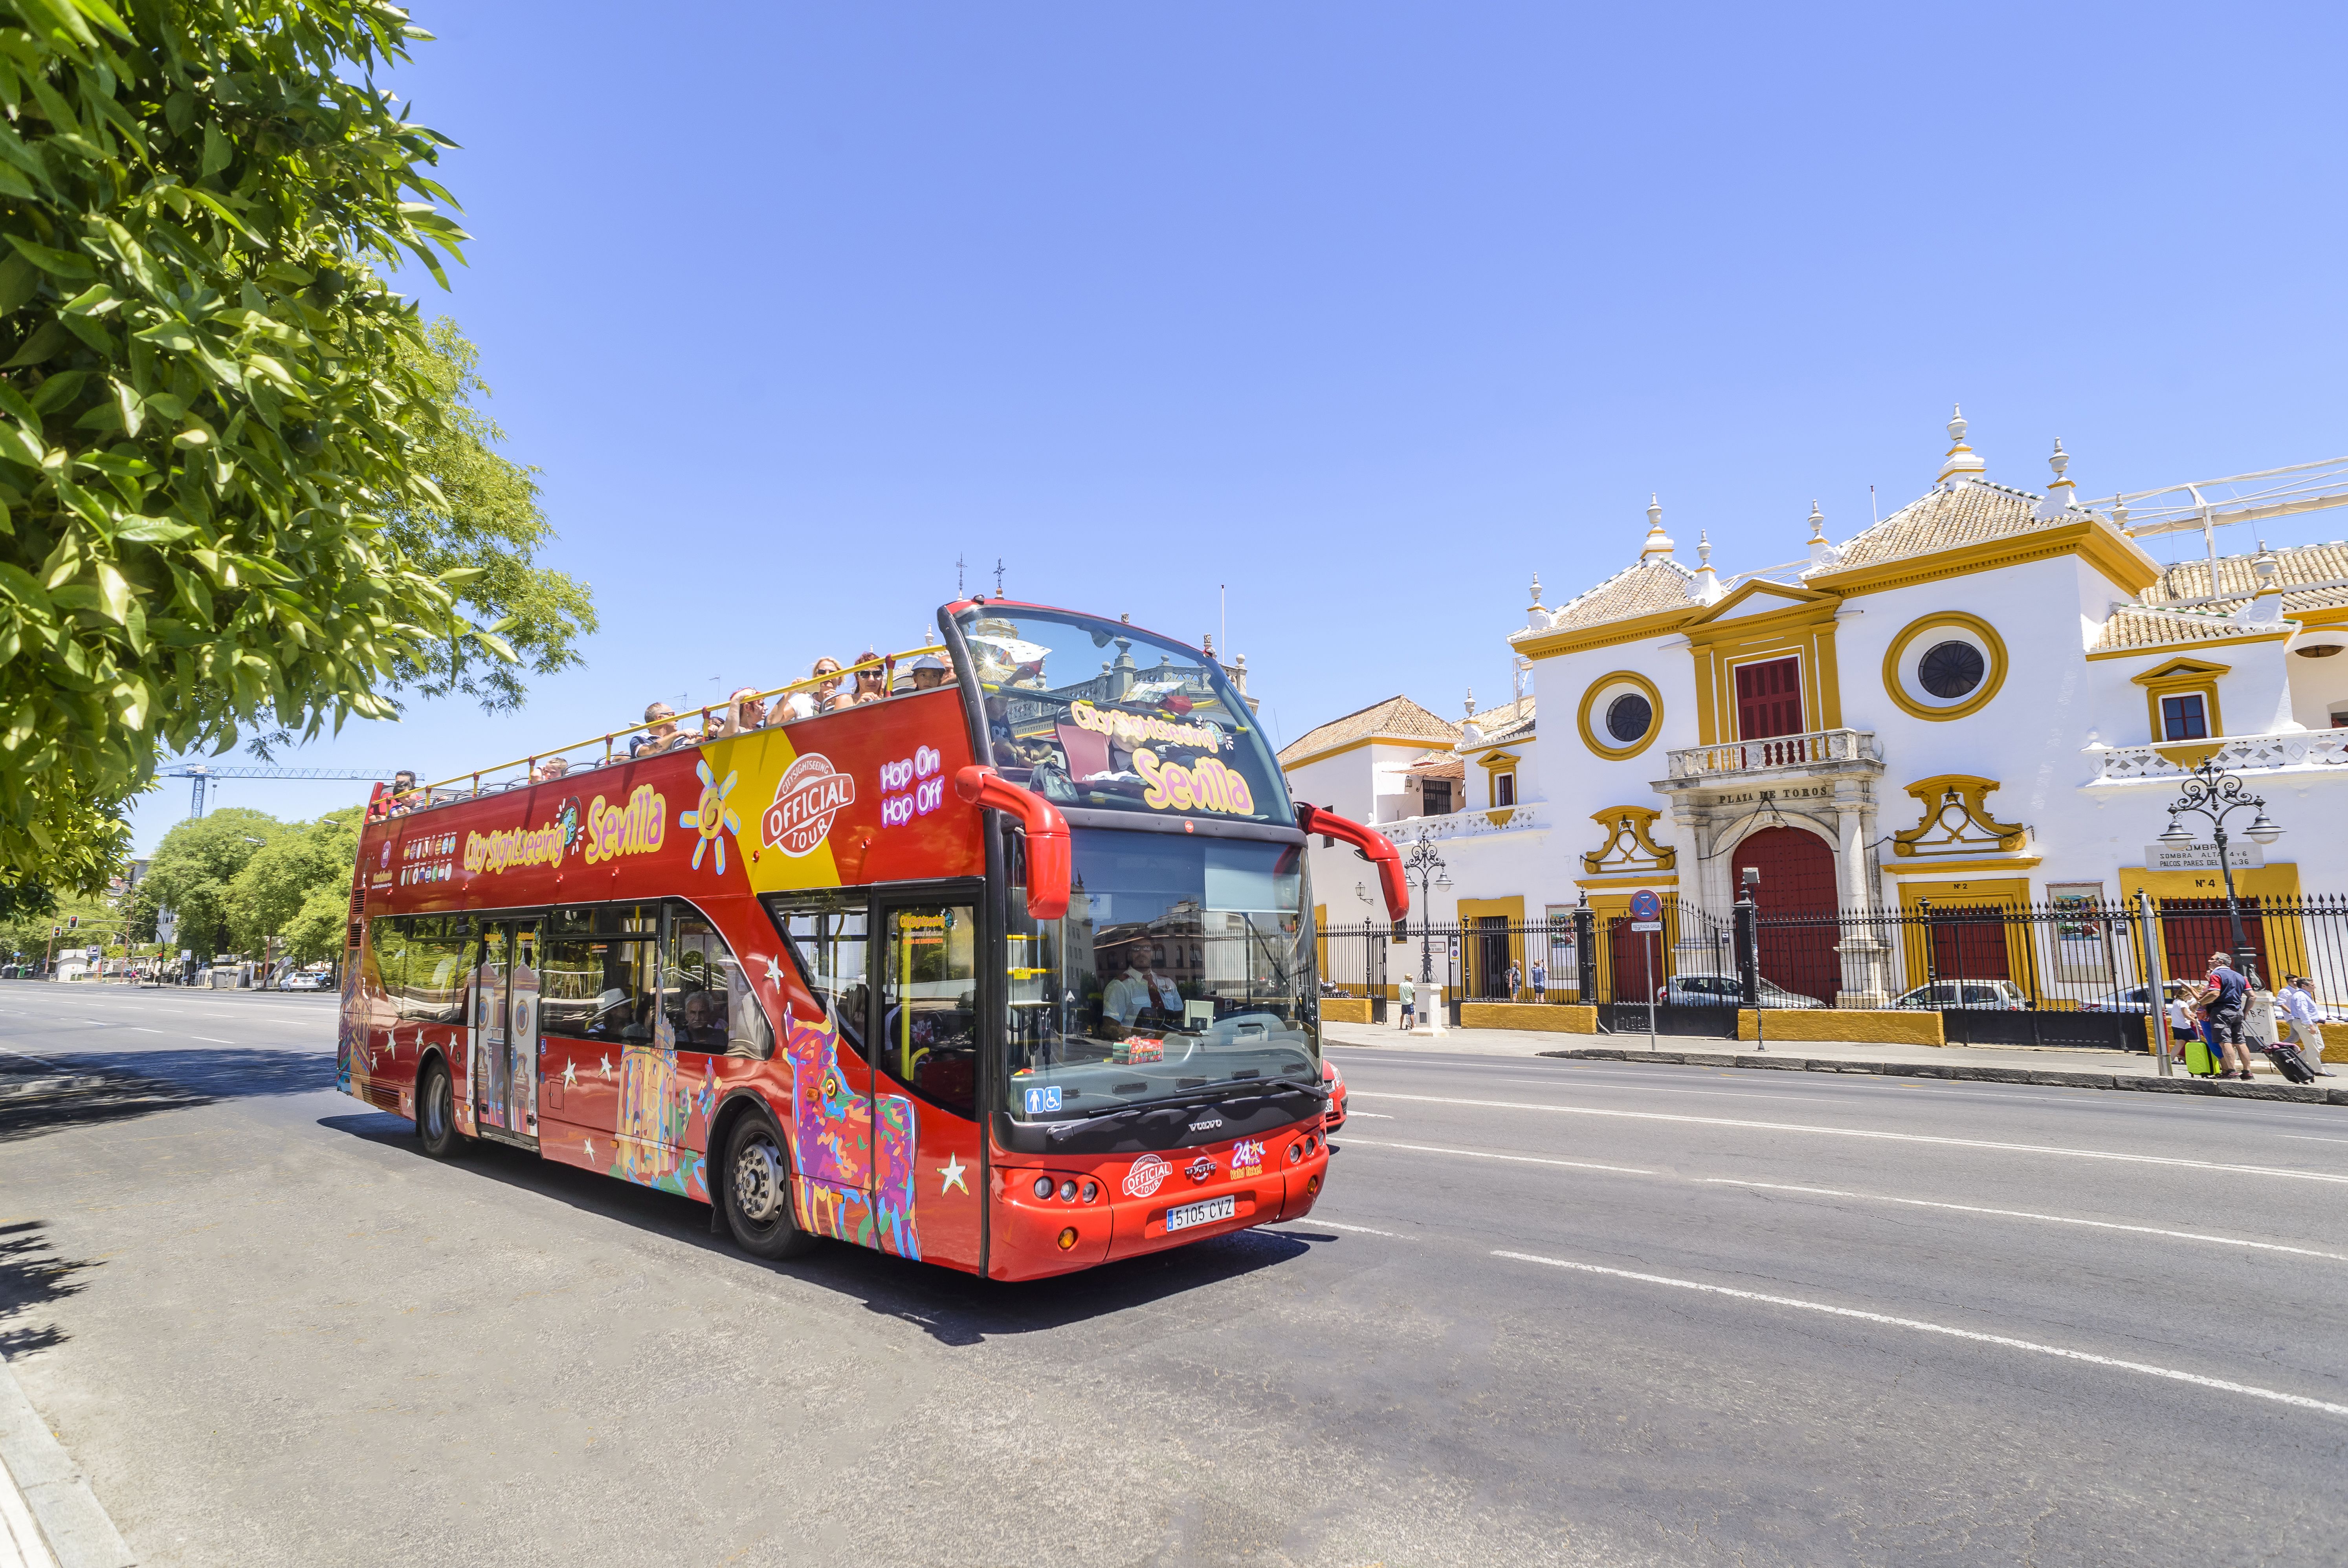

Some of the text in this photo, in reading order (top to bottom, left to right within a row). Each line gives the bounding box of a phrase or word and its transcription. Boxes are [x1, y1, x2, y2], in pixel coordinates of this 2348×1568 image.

[881, 747, 939, 791] Hop On
[1135, 751, 1252, 812] Sevilla
[770, 779, 849, 836] OFFICIAL
[882, 777, 943, 826] Hop Off
[1719, 793, 1754, 804] PLAZA
[1783, 787, 1827, 798] TOROS
[587, 788, 664, 861] Sevilla
[792, 818, 827, 849] TOUR
[2208, 879, 2216, 887] 4
[1189, 1119, 1222, 1131] VOLVO
[1128, 1164, 1170, 1190] OFFICIAL
[1141, 1180, 1159, 1194] TOUR
[1176, 1199, 1232, 1226] 5105 CVZ
